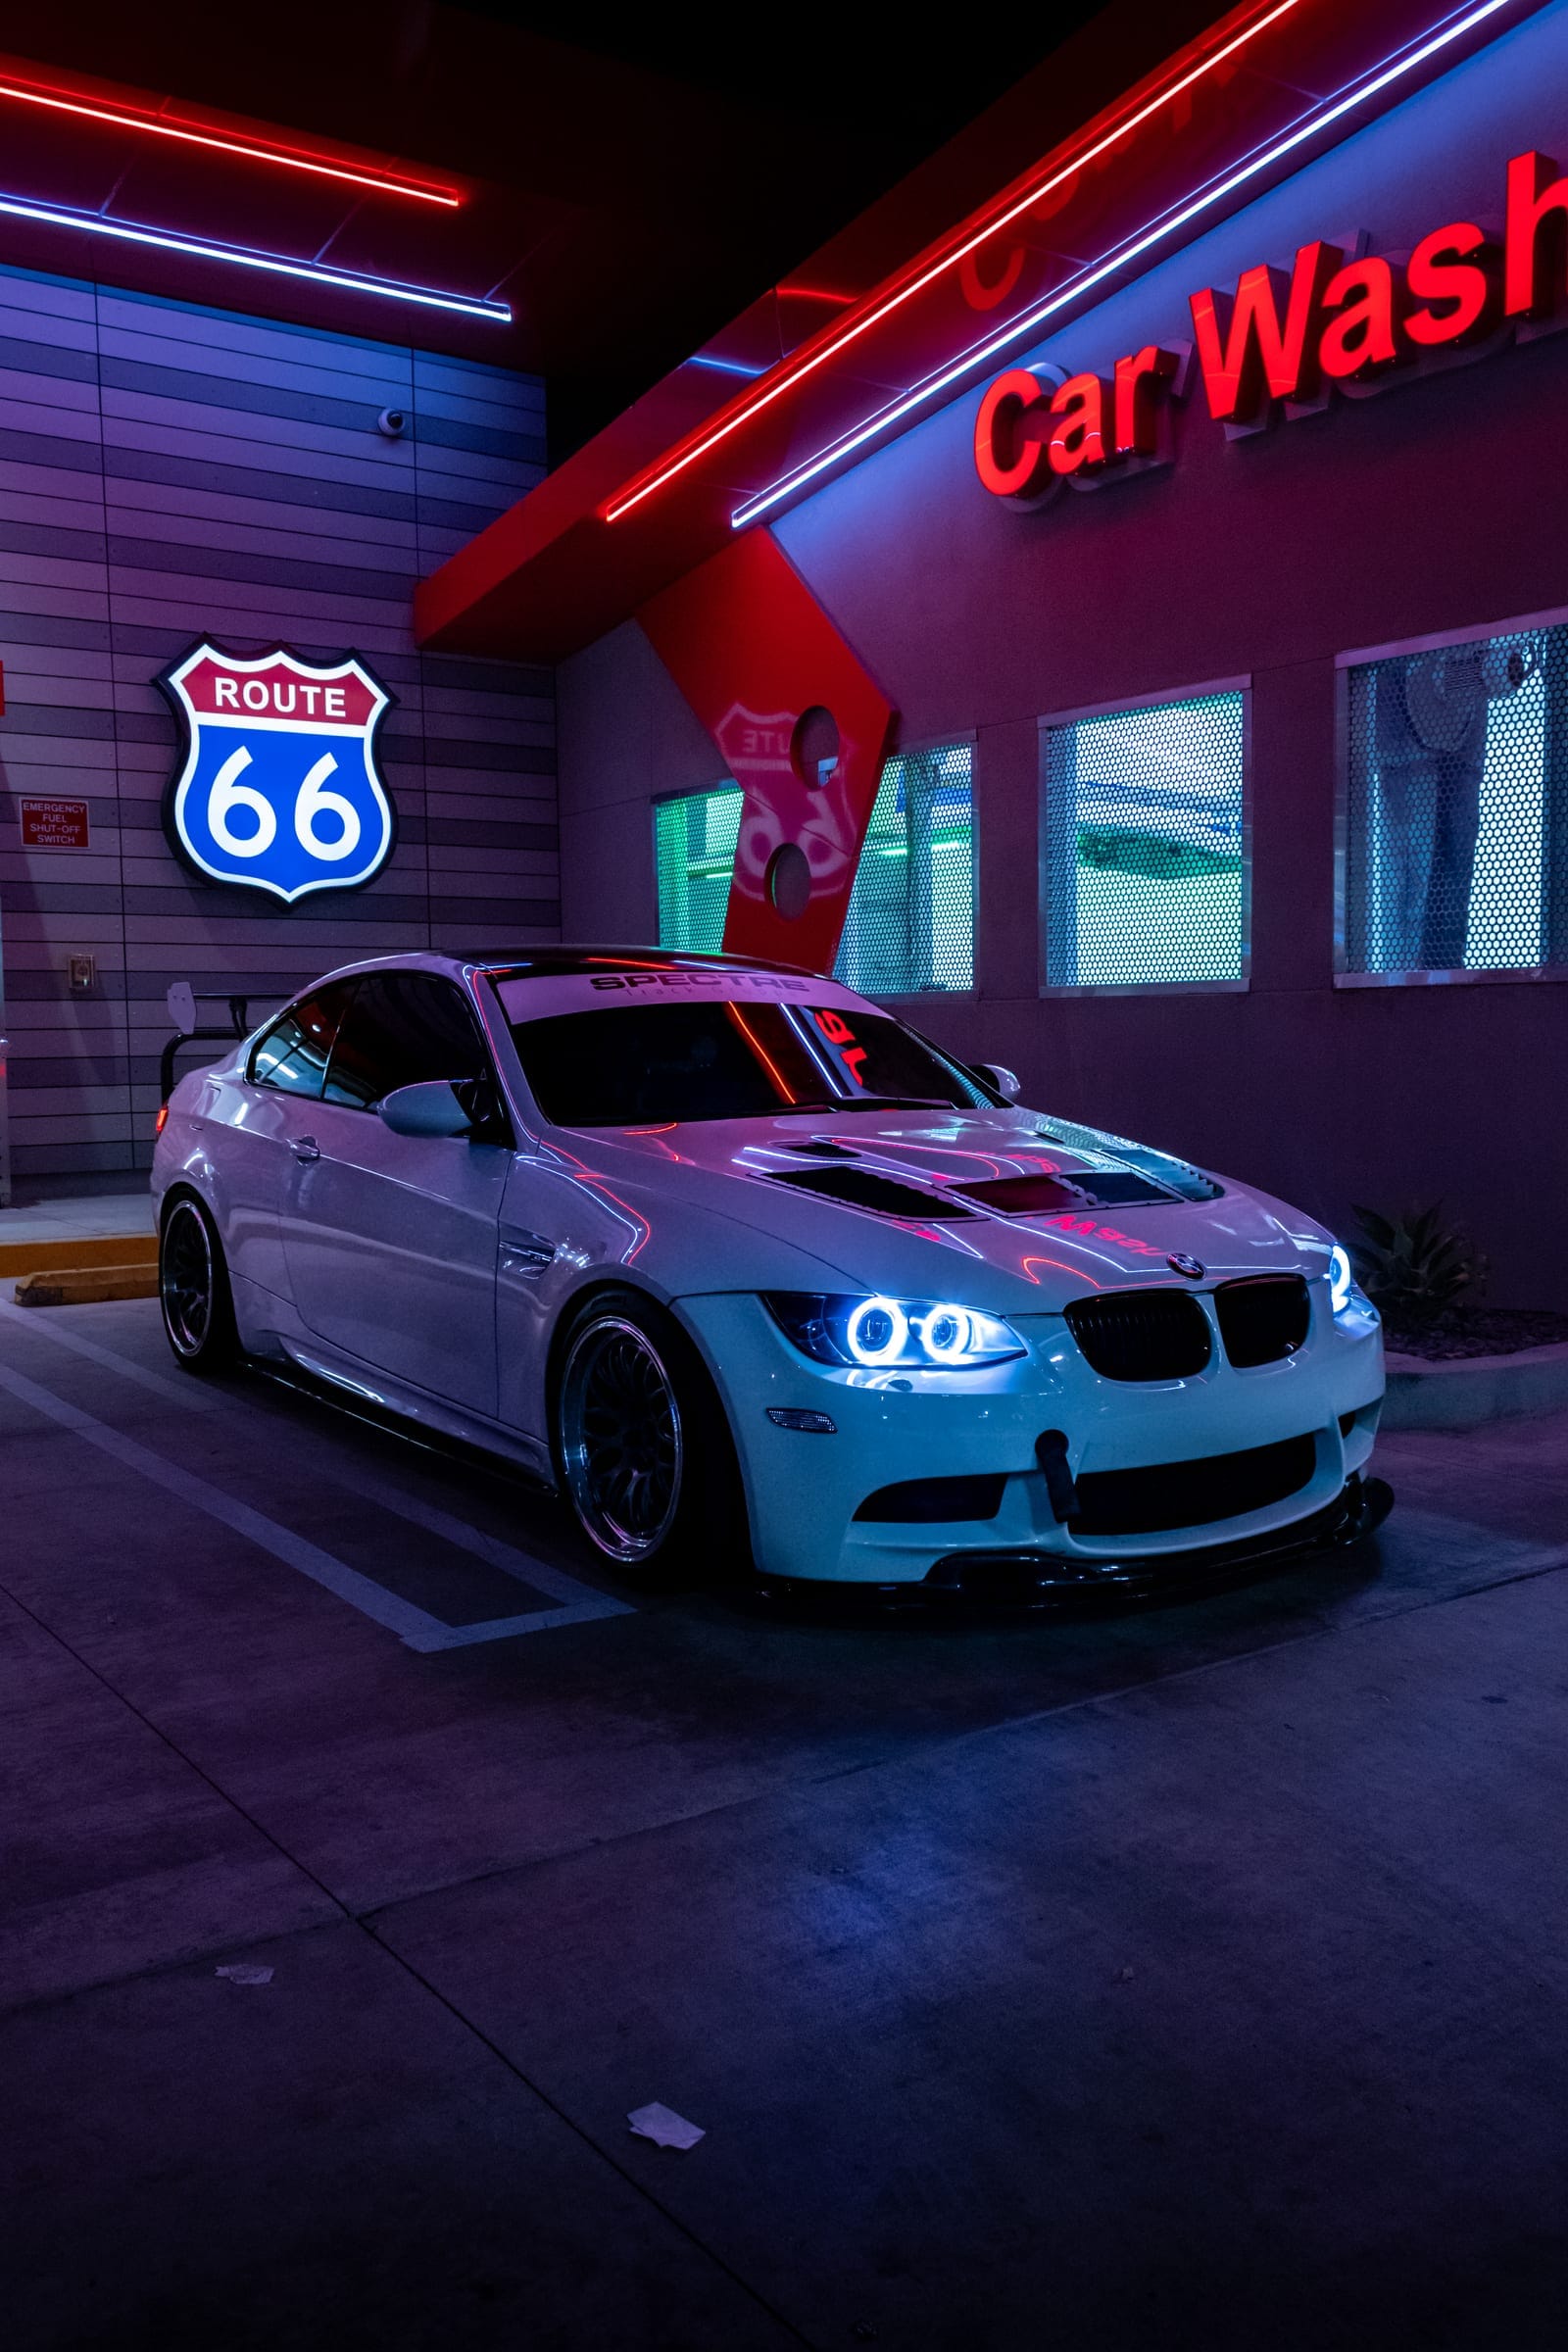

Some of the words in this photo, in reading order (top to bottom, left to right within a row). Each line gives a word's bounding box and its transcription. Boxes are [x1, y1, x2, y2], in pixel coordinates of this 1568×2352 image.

[974, 345, 1163, 498] Car
[1189, 150, 1568, 420] Wash
[215, 677, 347, 716] ROUTE
[24, 802, 85, 813] EMERGENCY
[207, 745, 362, 861] 66
[42, 813, 67, 823] FUEL
[30, 824, 80, 833] SHUT-OFF
[37, 835, 74, 844] SWITCH
[590, 974, 809, 991] SPECTRE
